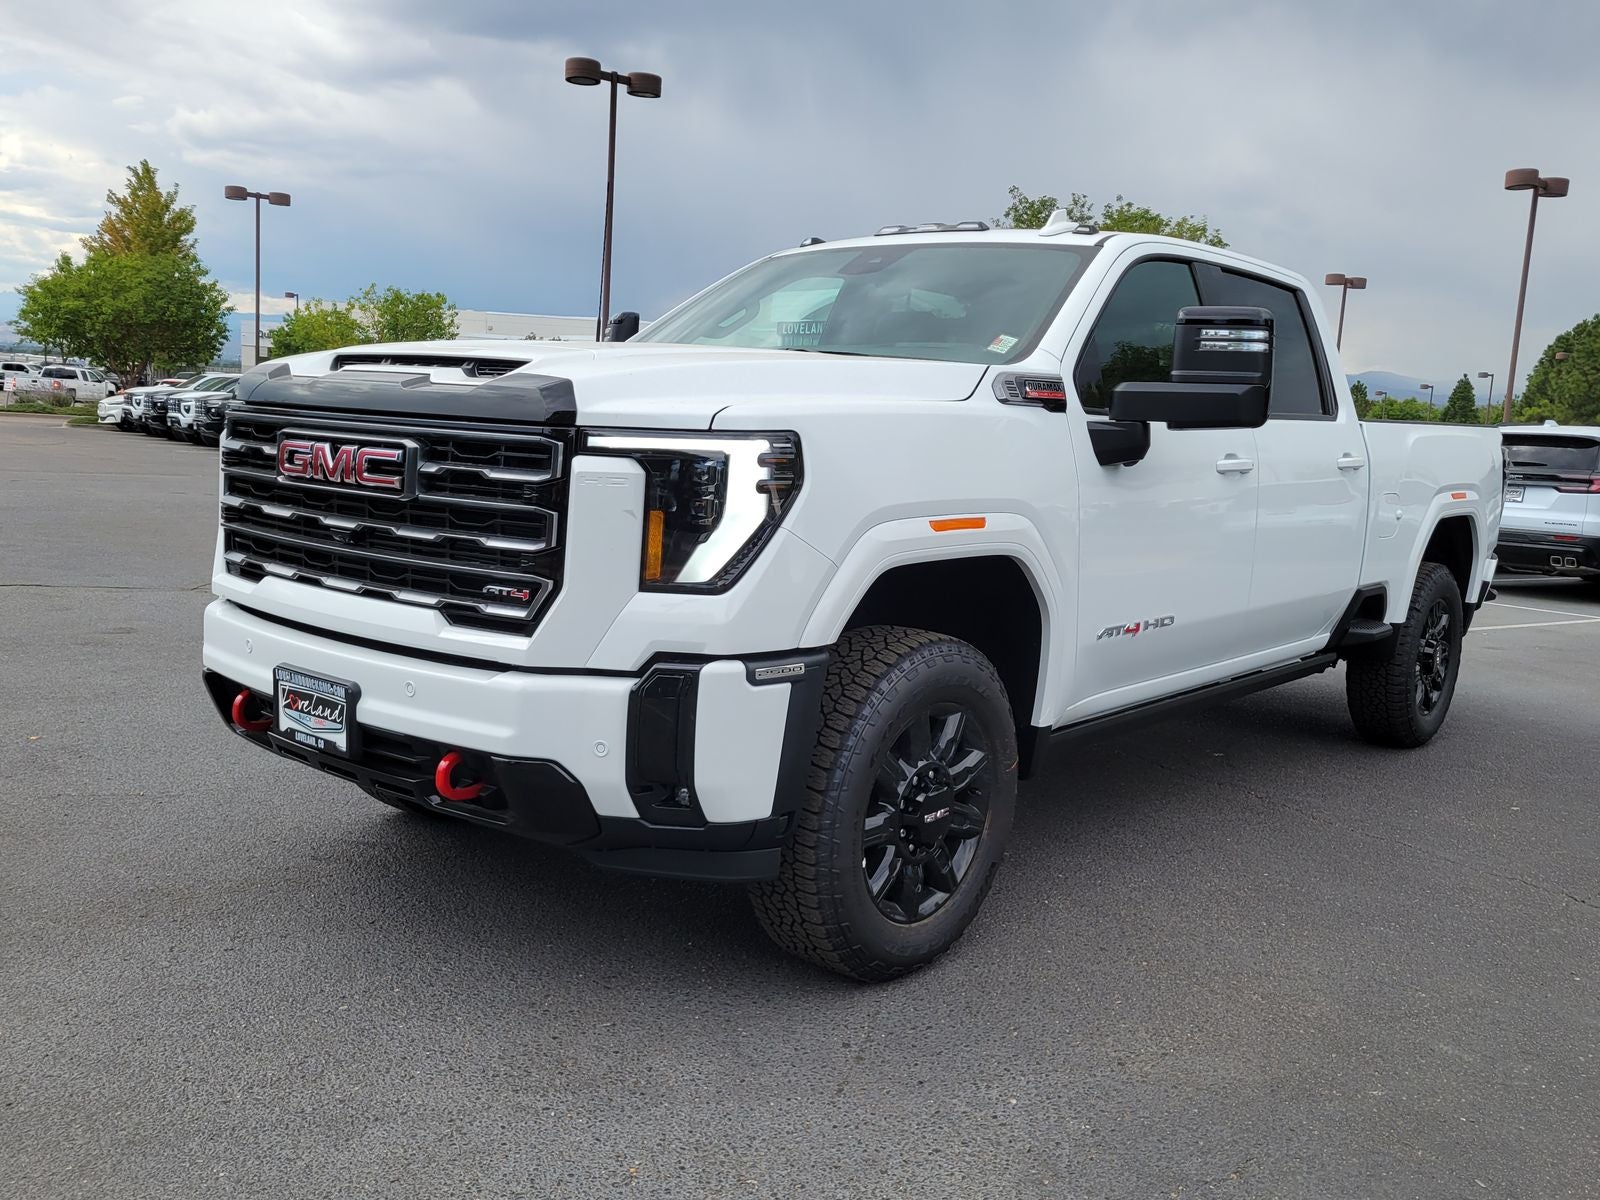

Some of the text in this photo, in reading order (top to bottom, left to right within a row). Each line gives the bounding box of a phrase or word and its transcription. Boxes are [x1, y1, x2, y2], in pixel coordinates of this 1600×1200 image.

[1027, 382, 1063, 393] DURAMAX
[279, 439, 402, 489] GMC
[482, 585, 530, 601] AT4
[1096, 615, 1175, 640] AT4 HD
[757, 665, 803, 678] 2500
[281, 686, 343, 723] Loveland
